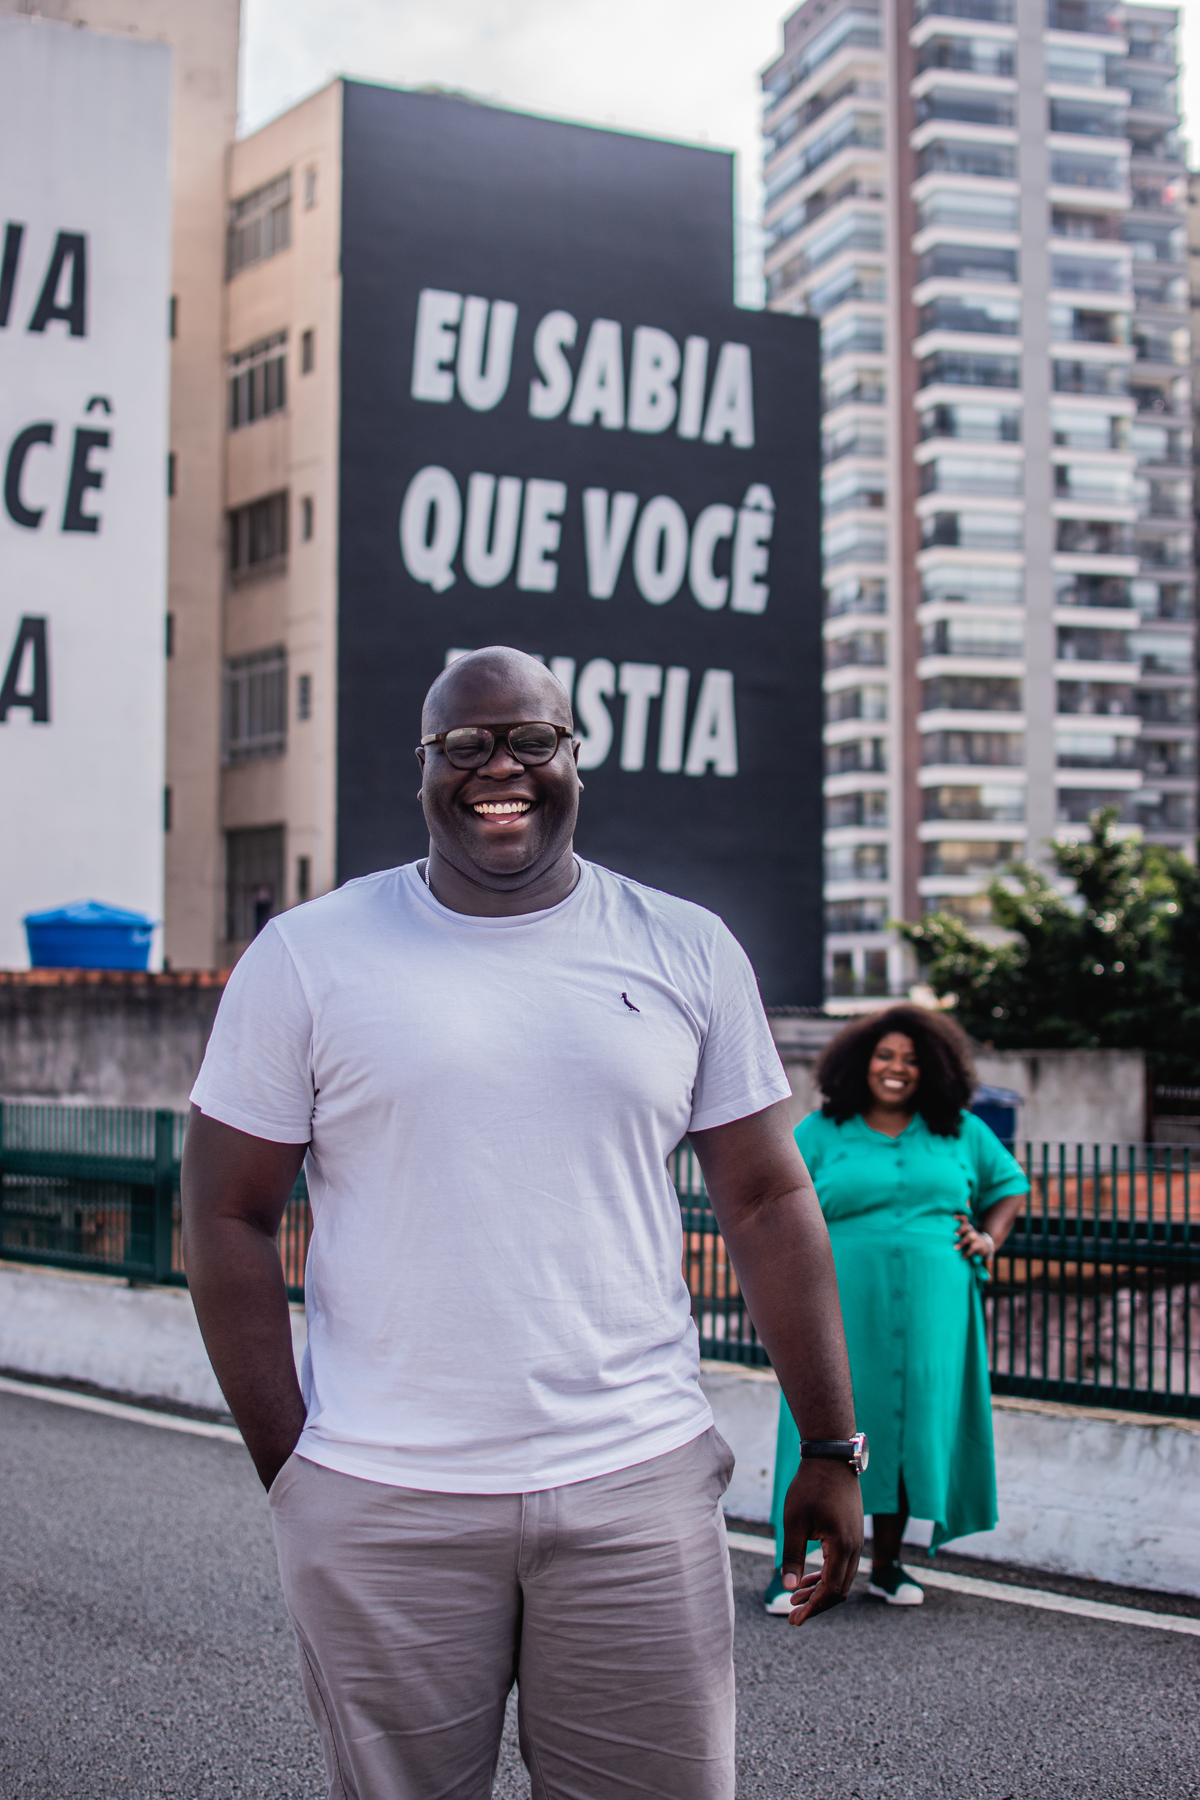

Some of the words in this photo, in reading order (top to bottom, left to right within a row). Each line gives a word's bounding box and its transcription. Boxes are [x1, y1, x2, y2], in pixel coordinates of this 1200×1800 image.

[411, 288, 518, 411] EU
[529, 310, 754, 448] SABIA
[3, 396, 112, 534] CÊ
[400, 466, 567, 592] QUE
[583, 484, 775, 613] VOCÊ
[0, 615, 51, 724] A
